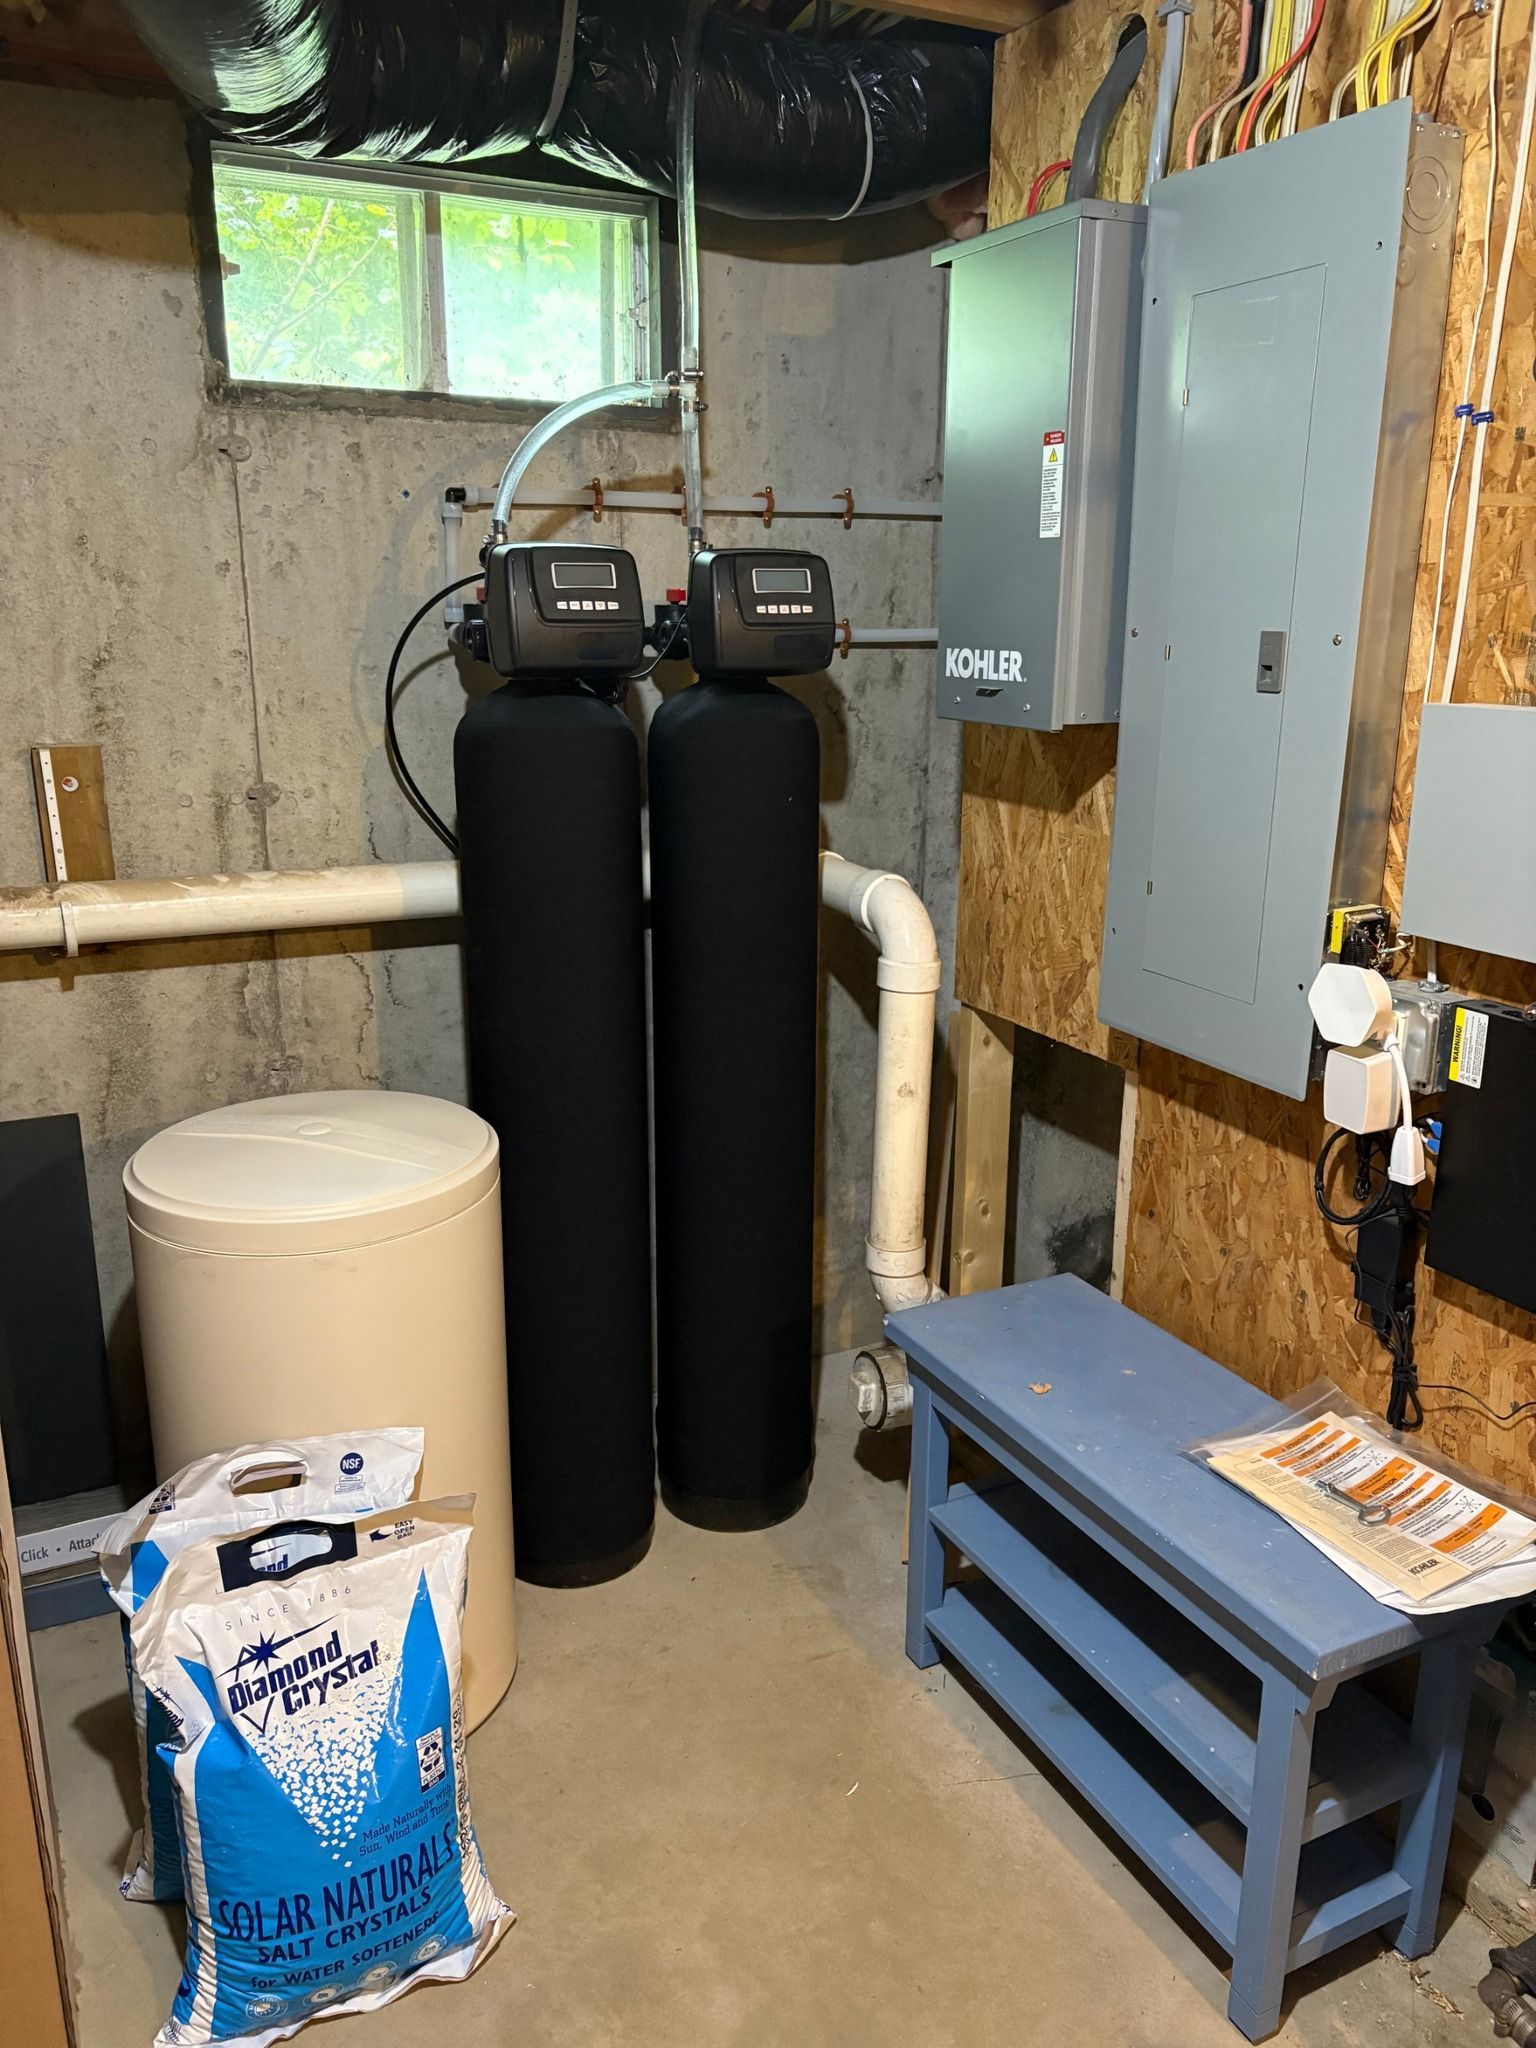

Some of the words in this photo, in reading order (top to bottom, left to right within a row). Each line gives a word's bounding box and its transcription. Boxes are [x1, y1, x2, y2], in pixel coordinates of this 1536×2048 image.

[945, 648, 1023, 682] KOHLER
[1452, 1025, 1463, 1063] WARNING!
[342, 1458, 361, 1470] NSF
[394, 1519, 413, 1529] EASY
[394, 1525, 415, 1535] OPEN
[397, 1532, 413, 1540] BAG
[21, 1547, 49, 1563] Click
[69, 1534, 99, 1552] Attac
[1408, 1558, 1441, 1576] KOHLER
[225, 1604, 289, 1630] SINCE
[307, 1585, 351, 1606] 1886
[227, 1630, 342, 1715] Diamond
[282, 1639, 379, 1716] Crystal
[362, 1823, 391, 1842] Made
[392, 1798, 434, 1828] Naturally
[435, 1784, 451, 1801] with
[359, 1842, 382, 1857] Sun,
[385, 1824, 410, 1844] Wind
[412, 1814, 429, 1830] and
[218, 1893, 316, 1942] SOLAR
[322, 1821, 454, 1927] NATURALS
[258, 1936, 314, 1964] SALT
[325, 1885, 432, 1949] CRYSTALS
[251, 1974, 277, 1989] for
[284, 1959, 345, 1986] WATER
[351, 1911, 440, 1967] SOFTENERS
